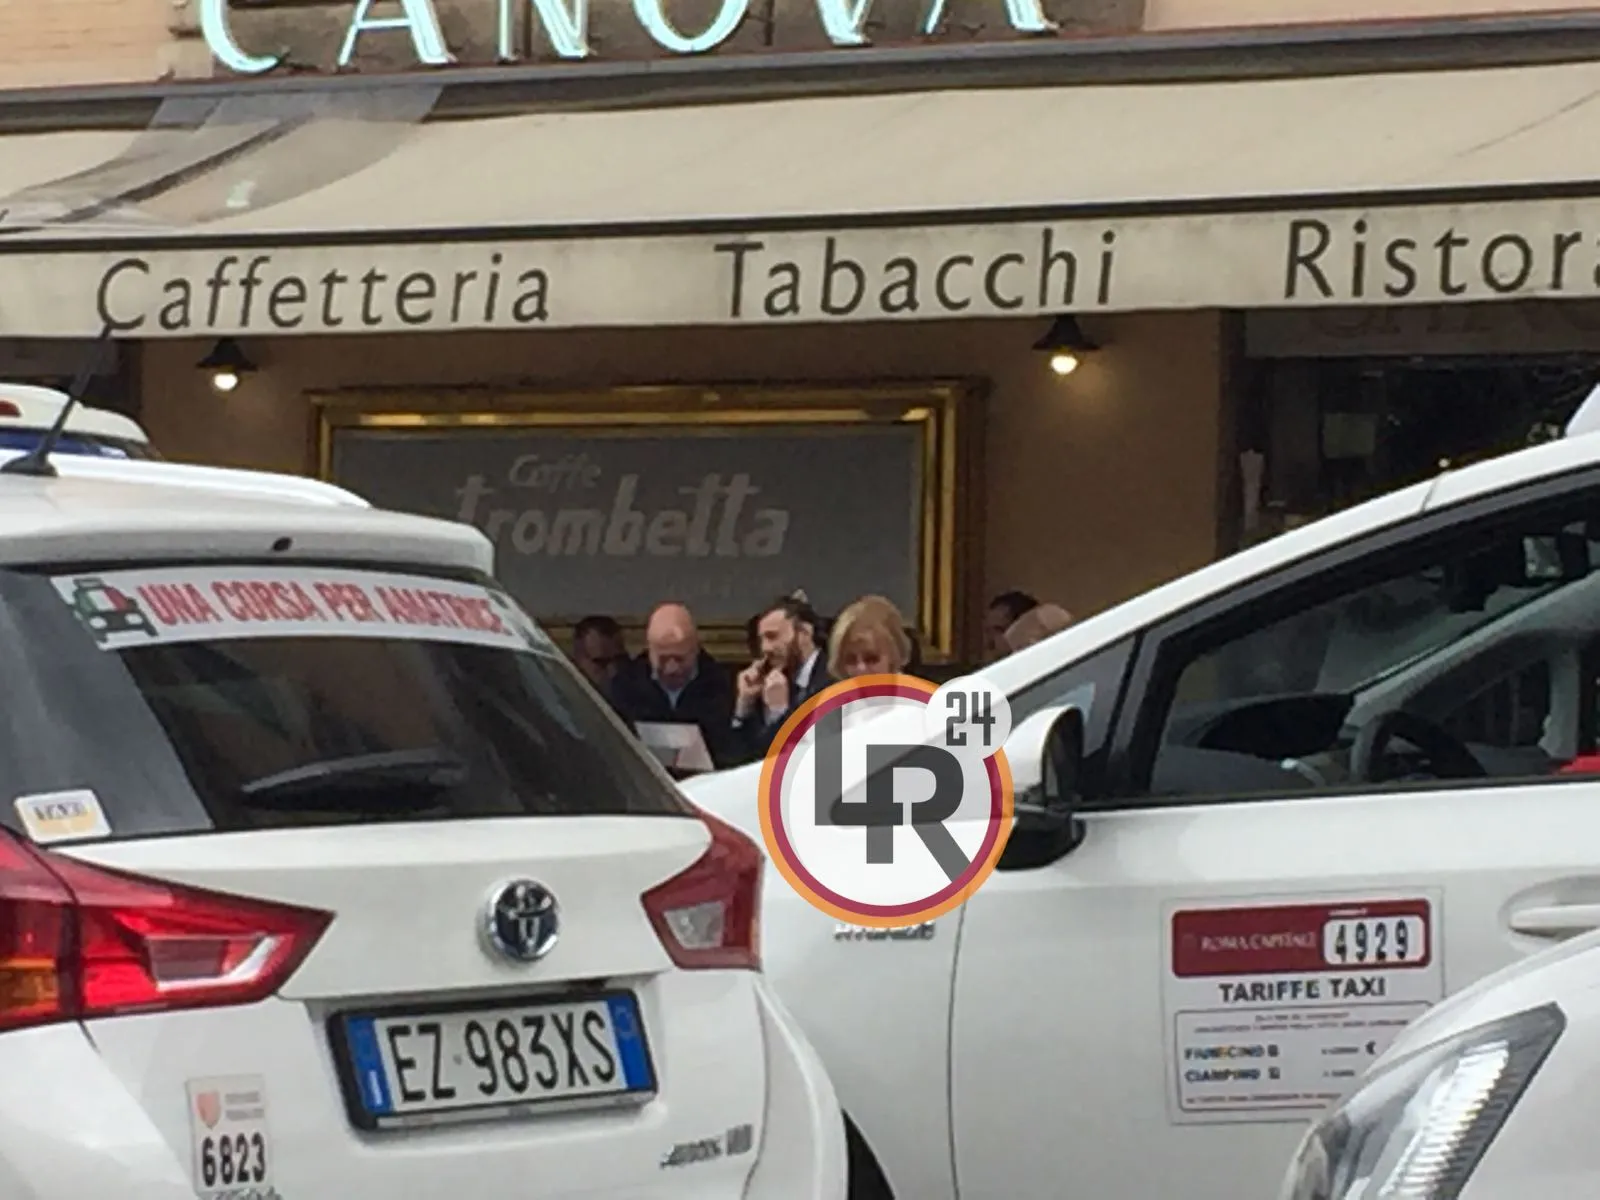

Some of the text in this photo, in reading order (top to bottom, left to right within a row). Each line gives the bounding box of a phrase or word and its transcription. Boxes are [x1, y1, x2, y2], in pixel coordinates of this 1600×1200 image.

[97, 253, 550, 333] Caffetteria
[714, 228, 1117, 319] Tabacchi
[455, 474, 790, 557] trombetta
[137, 583, 223, 625] UNA
[211, 581, 328, 622] CORSA
[313, 583, 385, 622] PER
[1335, 919, 1408, 962] 4929
[1219, 977, 1386, 1003] TARIFFE TAXI
[387, 1009, 617, 1103] EZ 983XS
[202, 1131, 266, 1187] 6823
